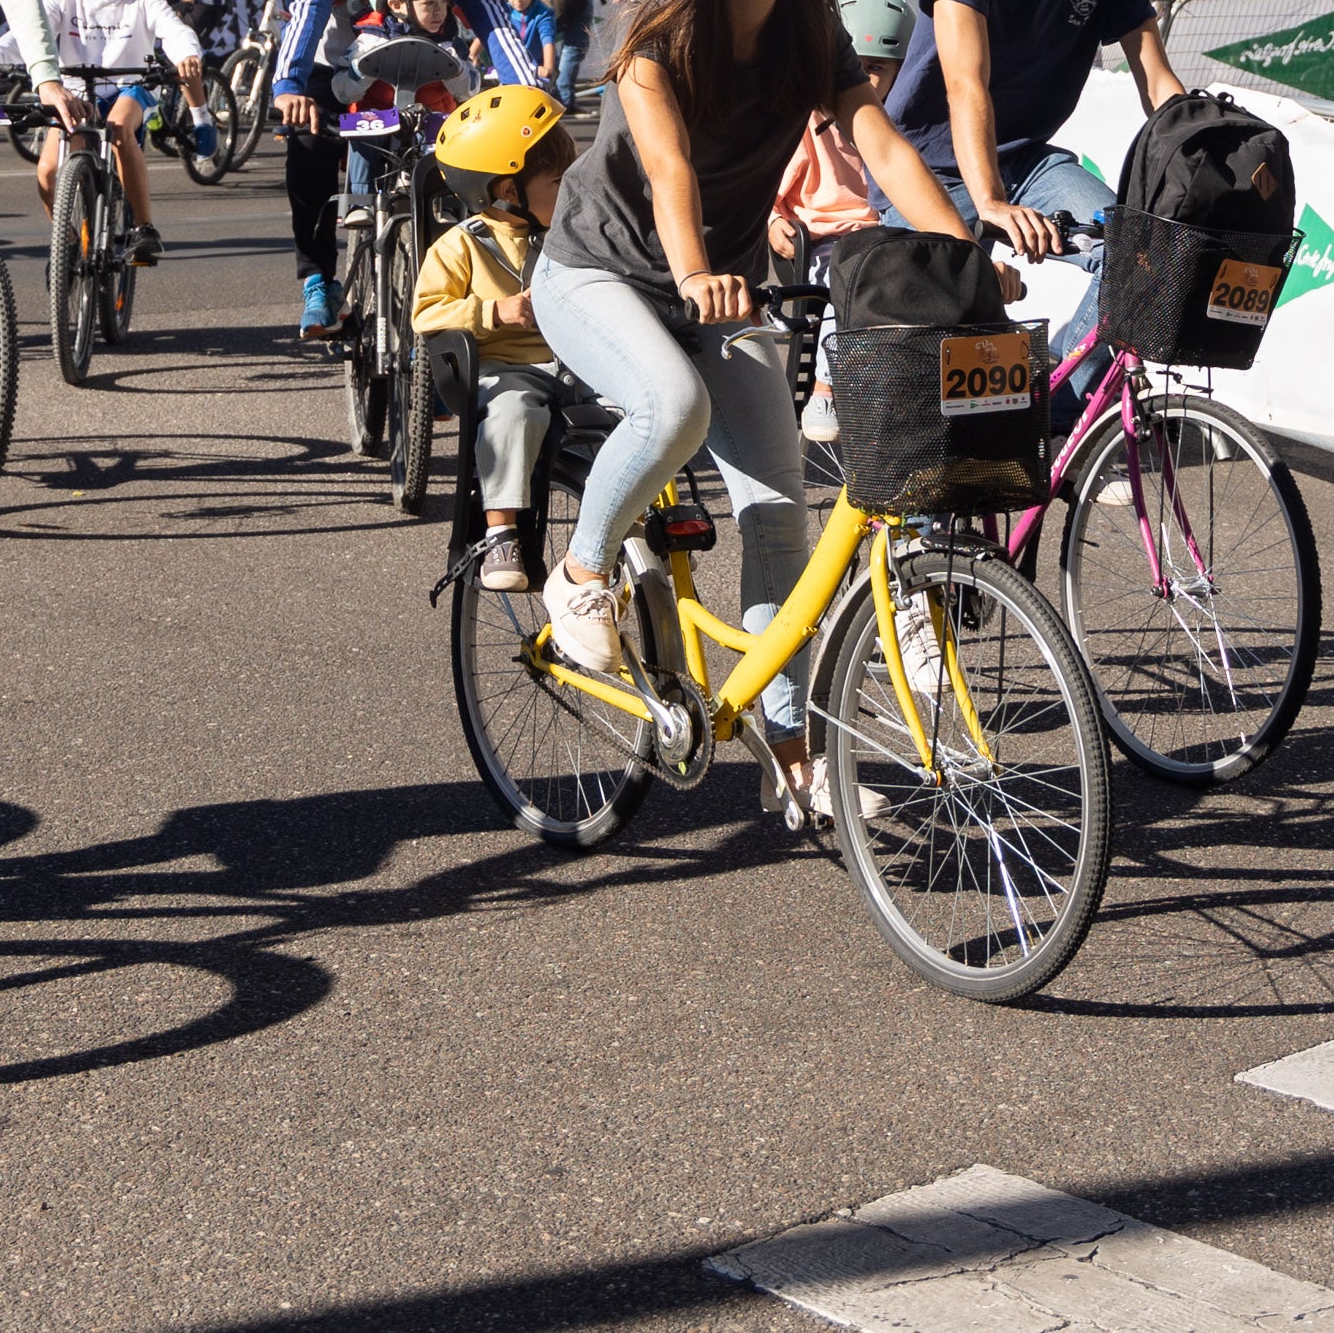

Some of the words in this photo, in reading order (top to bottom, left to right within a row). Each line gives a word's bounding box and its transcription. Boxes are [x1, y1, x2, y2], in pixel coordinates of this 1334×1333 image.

[356, 120, 385, 131] 36
[1214, 283, 1269, 312] 2089
[946, 364, 1027, 398] 2090
